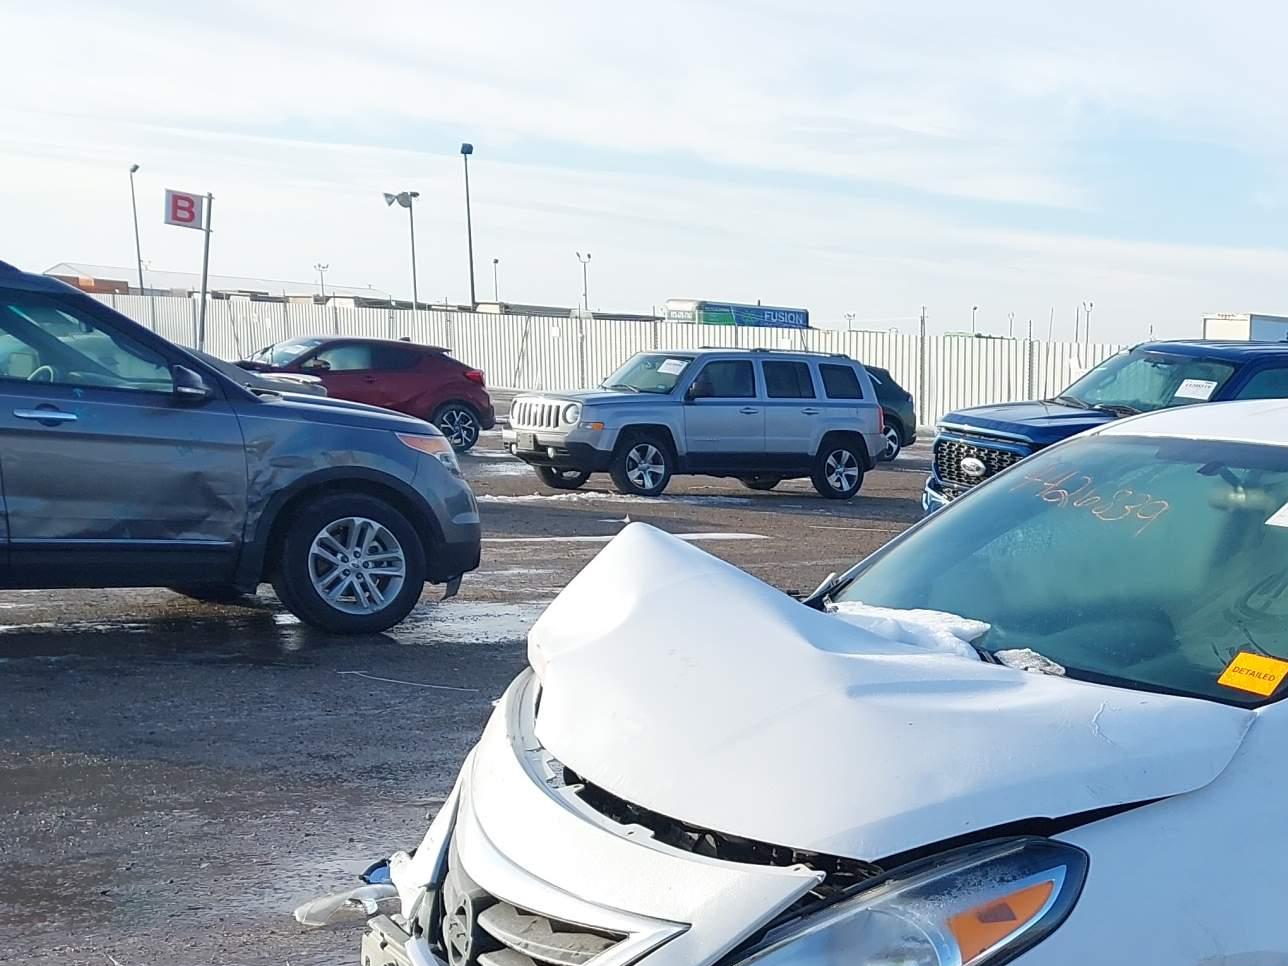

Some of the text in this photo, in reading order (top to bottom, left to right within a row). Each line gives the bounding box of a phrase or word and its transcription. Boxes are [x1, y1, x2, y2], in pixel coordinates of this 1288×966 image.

[172, 193, 195, 223] B
[764, 311, 803, 325] FUSION
[1232, 666, 1276, 682] DETAILED
